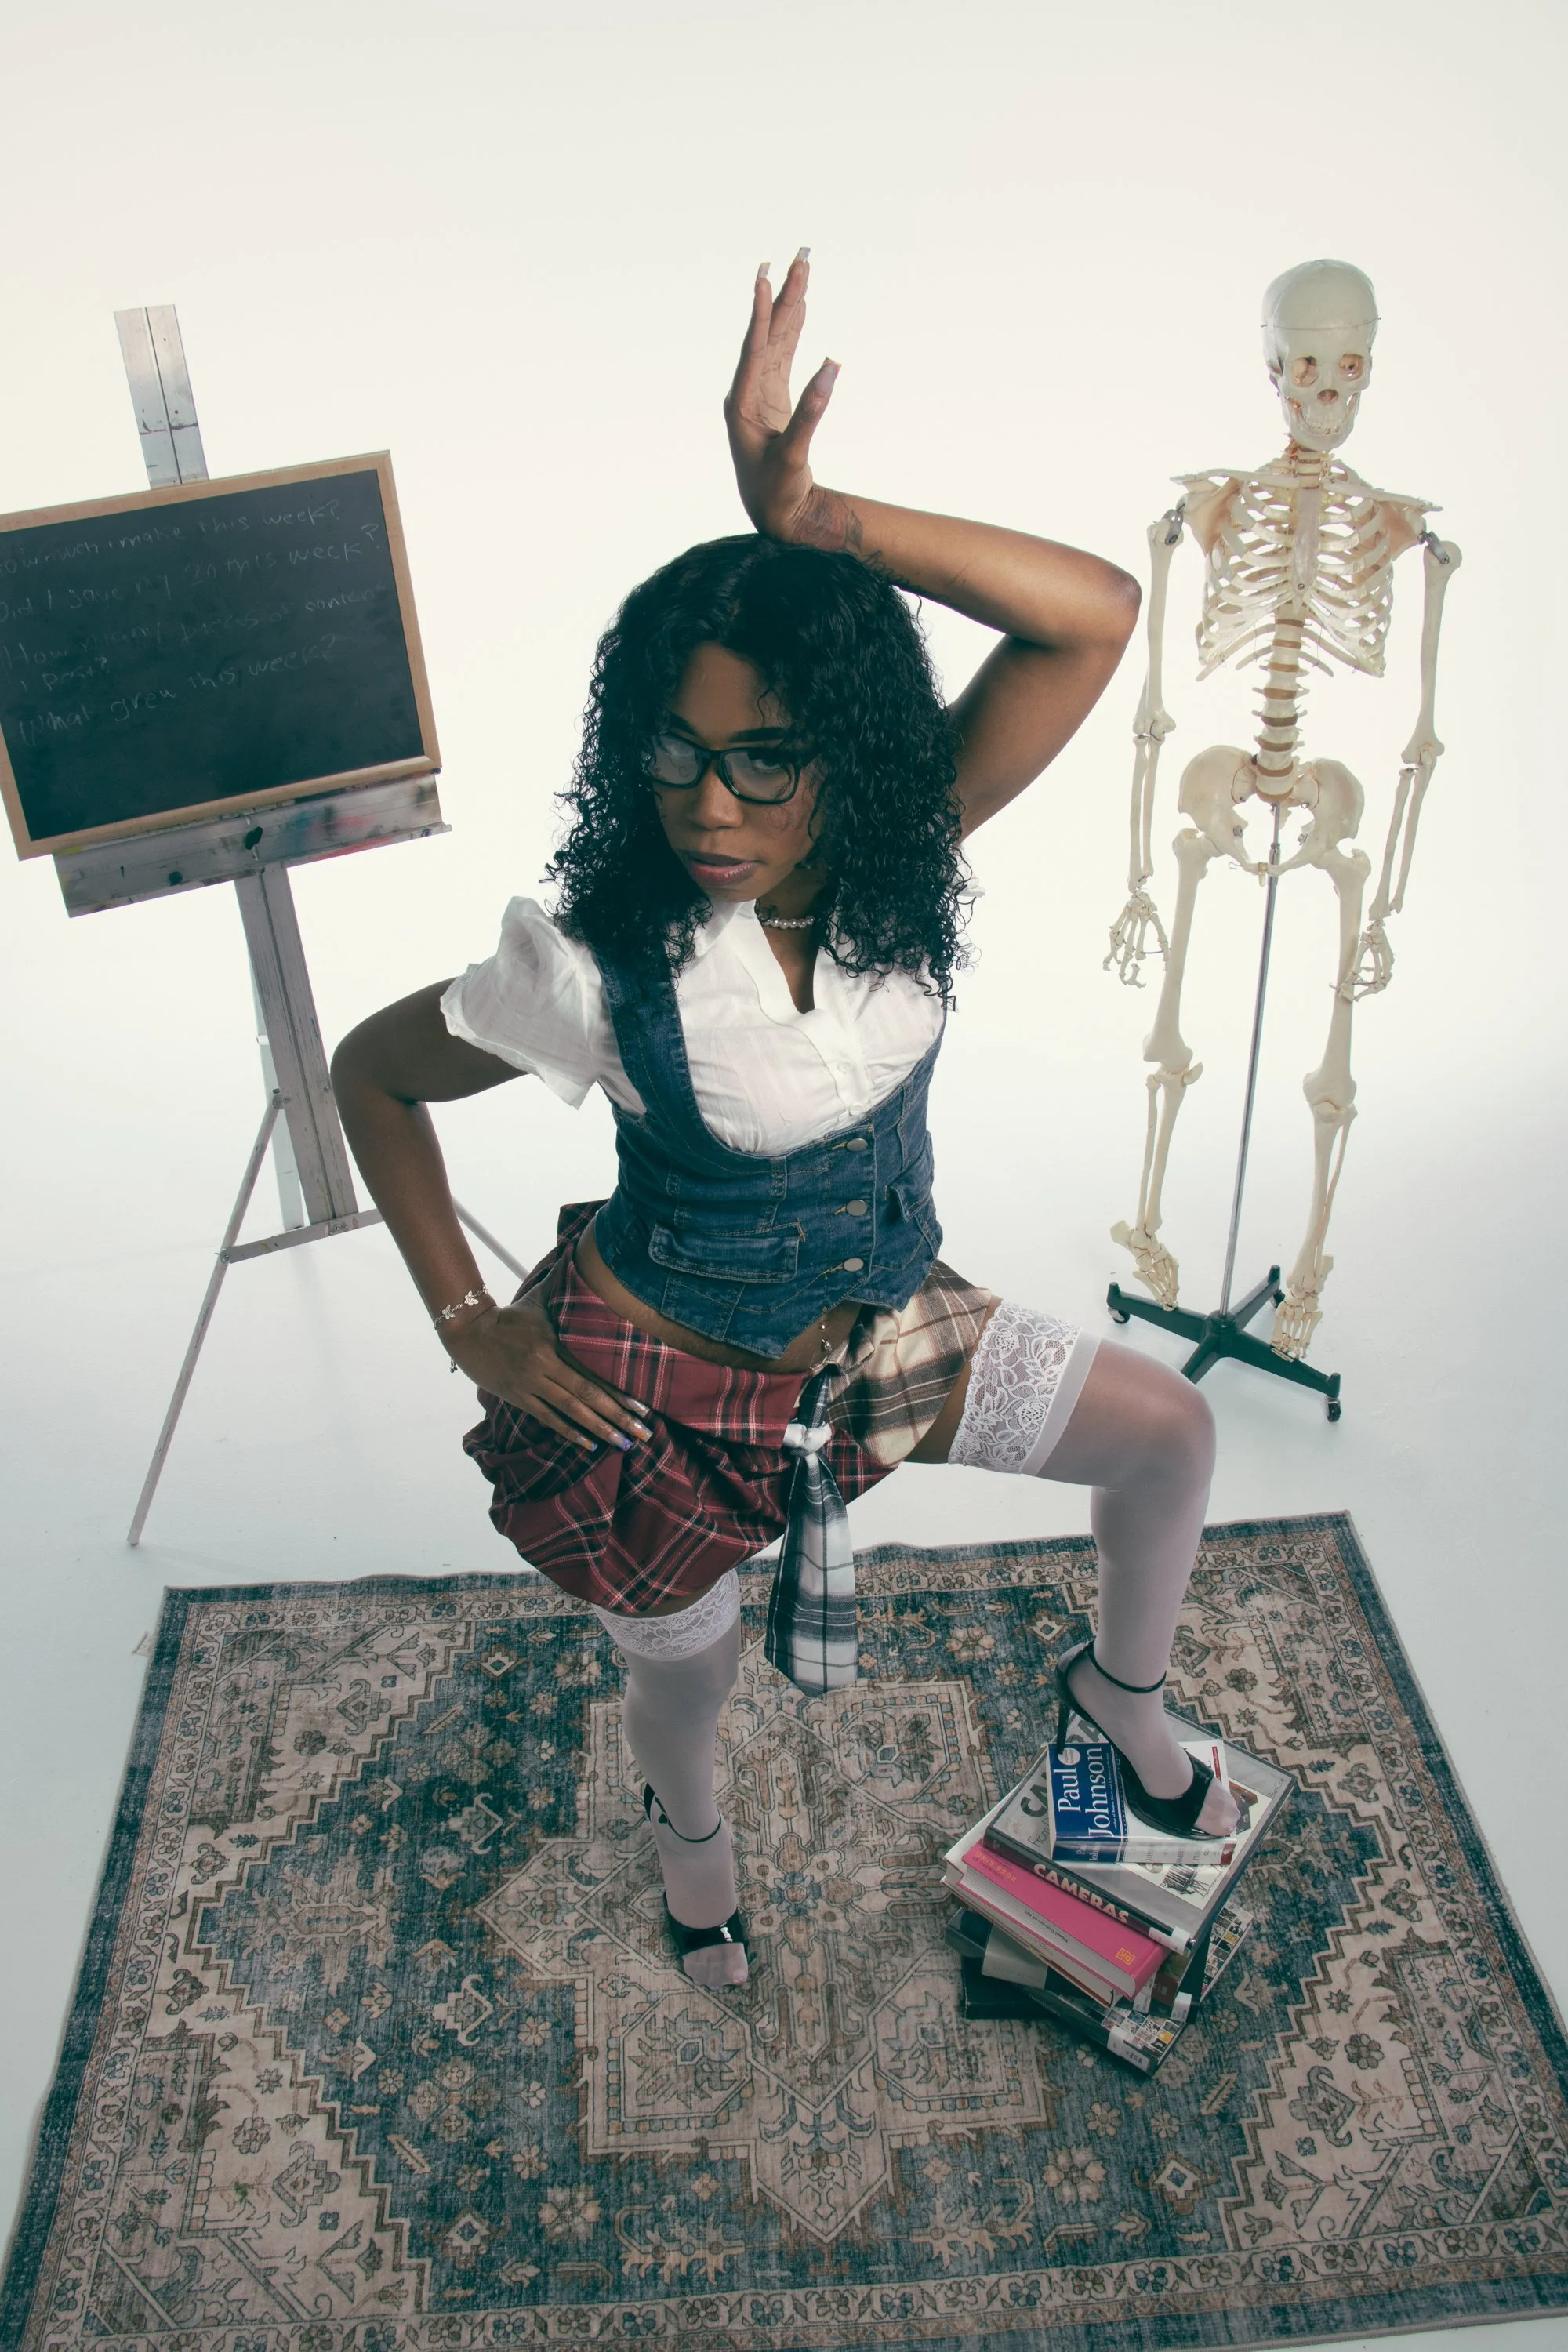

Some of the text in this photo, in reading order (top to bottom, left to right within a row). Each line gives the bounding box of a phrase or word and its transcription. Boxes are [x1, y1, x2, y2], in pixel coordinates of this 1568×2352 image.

[45, 540, 99, 562] much
[119, 527, 186, 549] make
[199, 517, 250, 534] this
[263, 499, 340, 527] week?
[3, 642, 67, 669] How
[20, 633, 336, 746] What grew this week?
[1053, 1767, 1081, 1813] Paul
[1085, 1746, 1115, 1838] Johnson
[1033, 1864, 1129, 1924] CAMERAS
